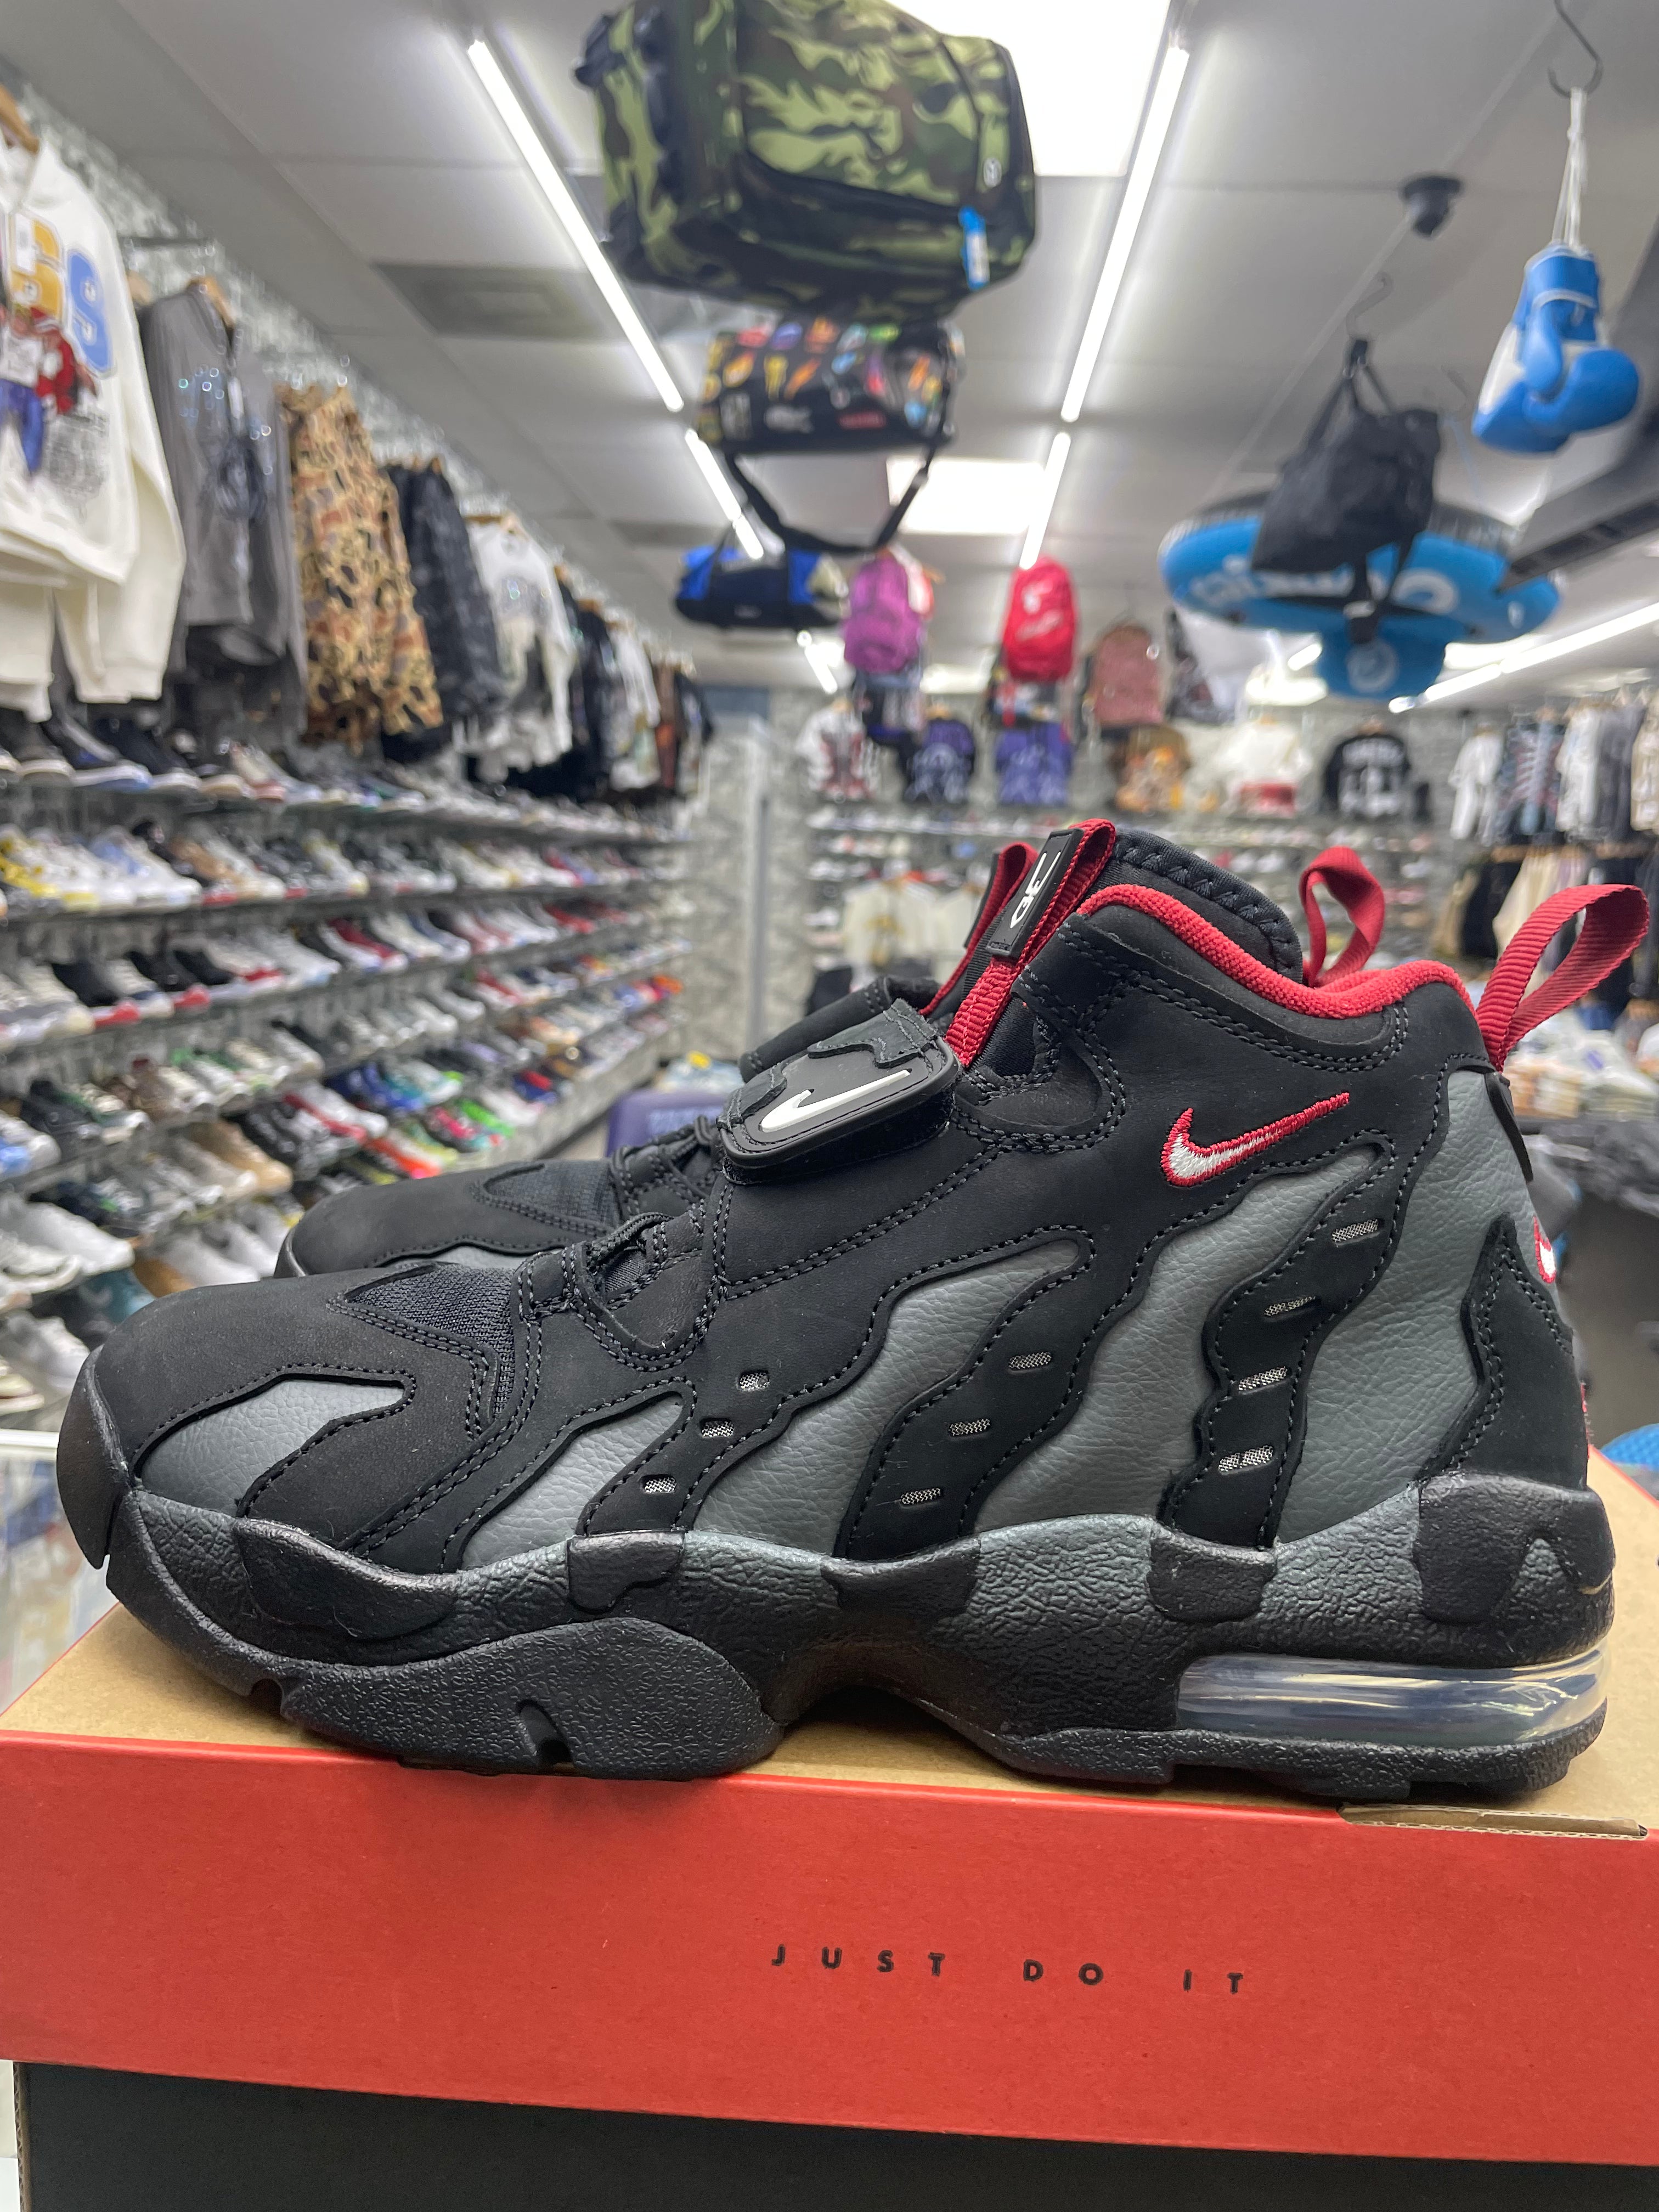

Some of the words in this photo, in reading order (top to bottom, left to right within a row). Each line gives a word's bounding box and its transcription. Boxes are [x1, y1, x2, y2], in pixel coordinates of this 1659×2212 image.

[771, 1944, 946, 1977] JUST
[1022, 1959, 1104, 1987] DO
[1182, 1969, 1244, 1995] IT
